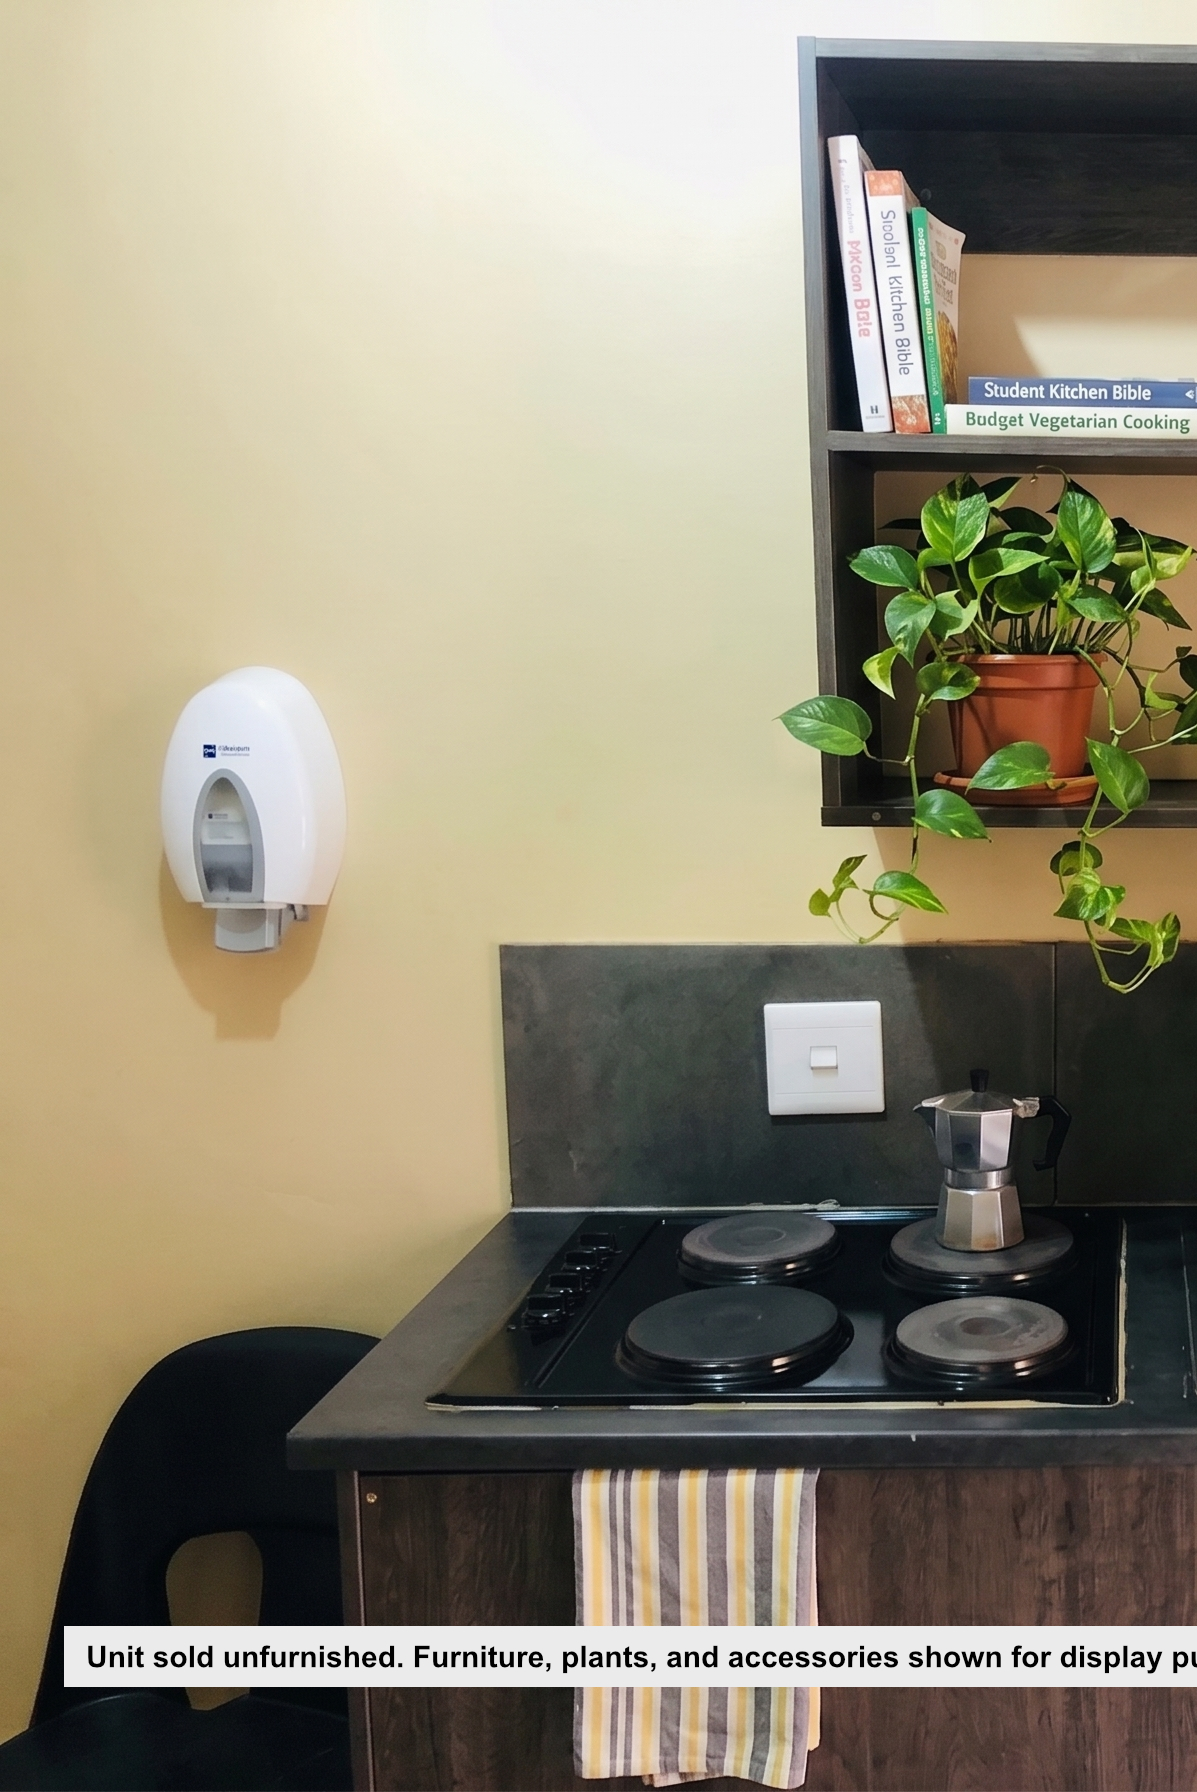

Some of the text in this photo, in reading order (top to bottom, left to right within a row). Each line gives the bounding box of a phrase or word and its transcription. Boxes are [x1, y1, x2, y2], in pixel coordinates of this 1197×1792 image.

[984, 381, 1152, 401] Student Kitchen Bible
[966, 411, 1190, 435] Budget Vegetarian Cooking
